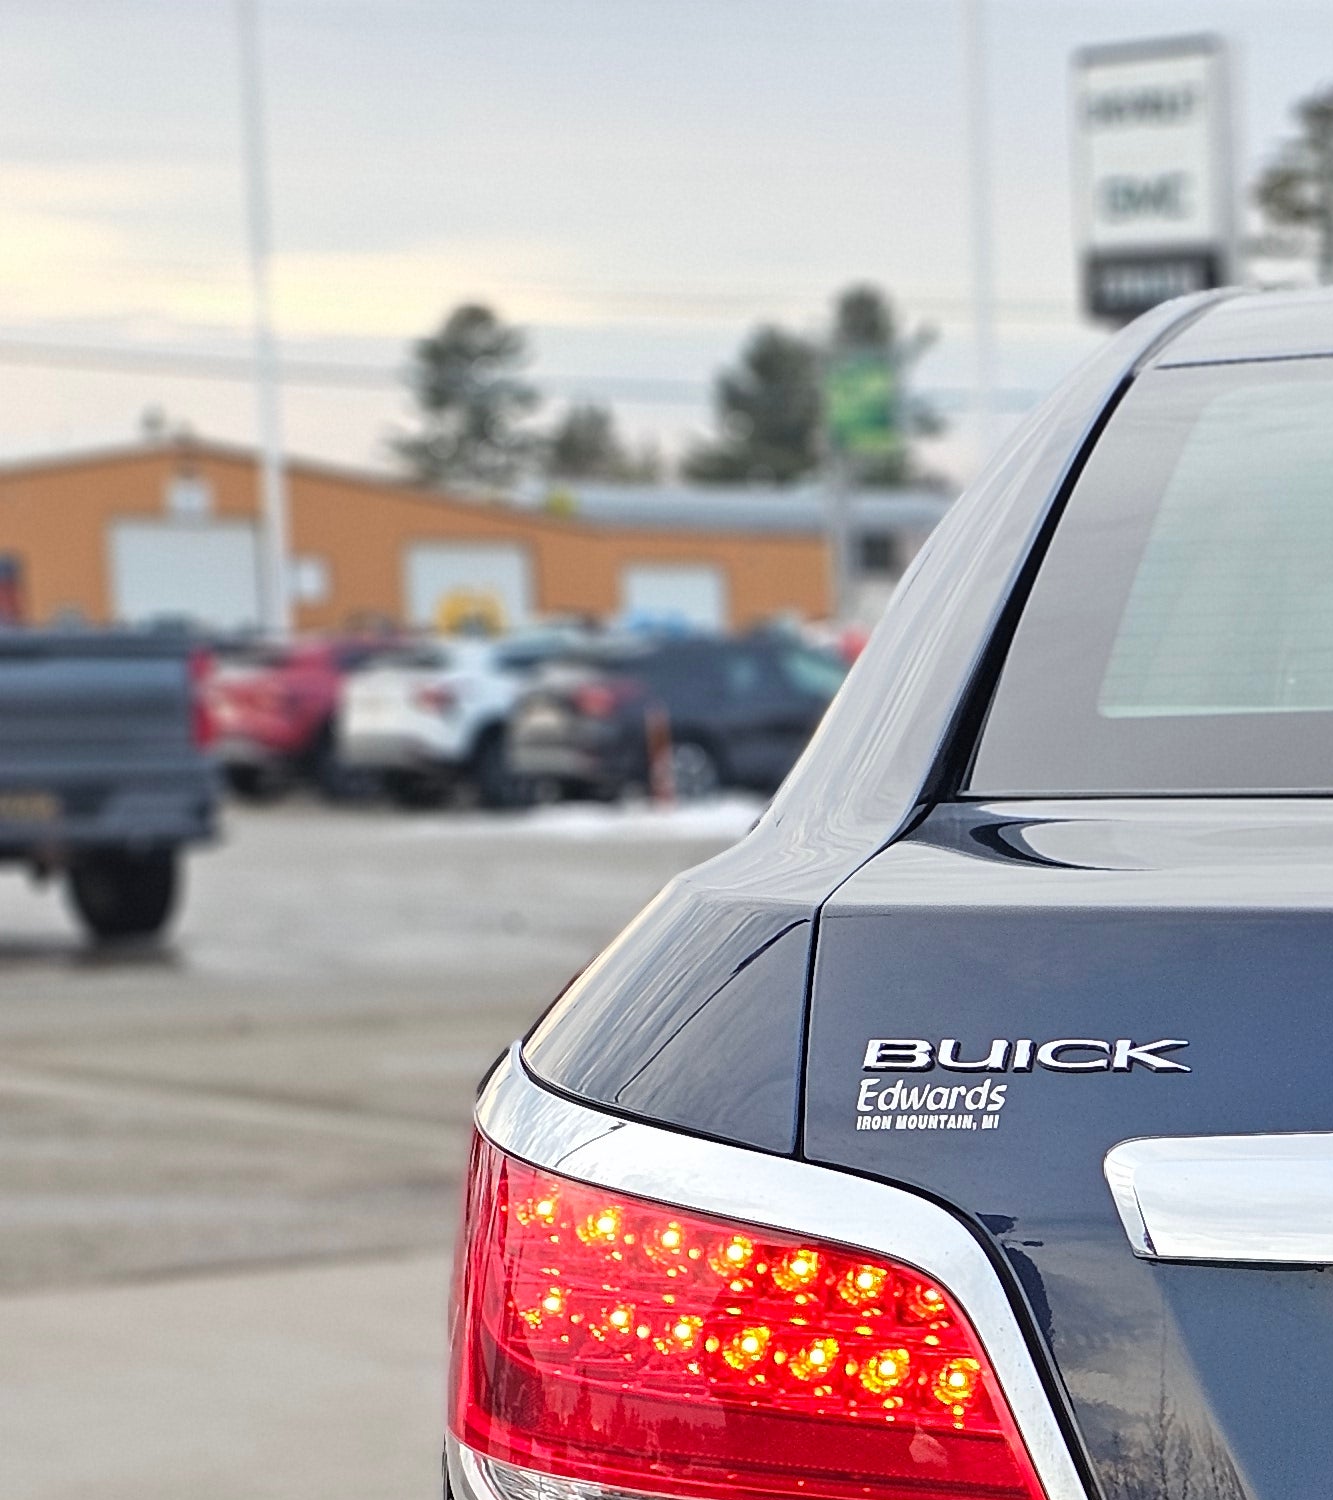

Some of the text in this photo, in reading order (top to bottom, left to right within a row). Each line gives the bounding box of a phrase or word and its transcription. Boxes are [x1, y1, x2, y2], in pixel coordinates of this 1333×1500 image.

[862, 1039, 1192, 1073] BUICK
[856, 1078, 1008, 1112] Edwards
[856, 1114, 999, 1131] IRON MOUNTAIN, MI
